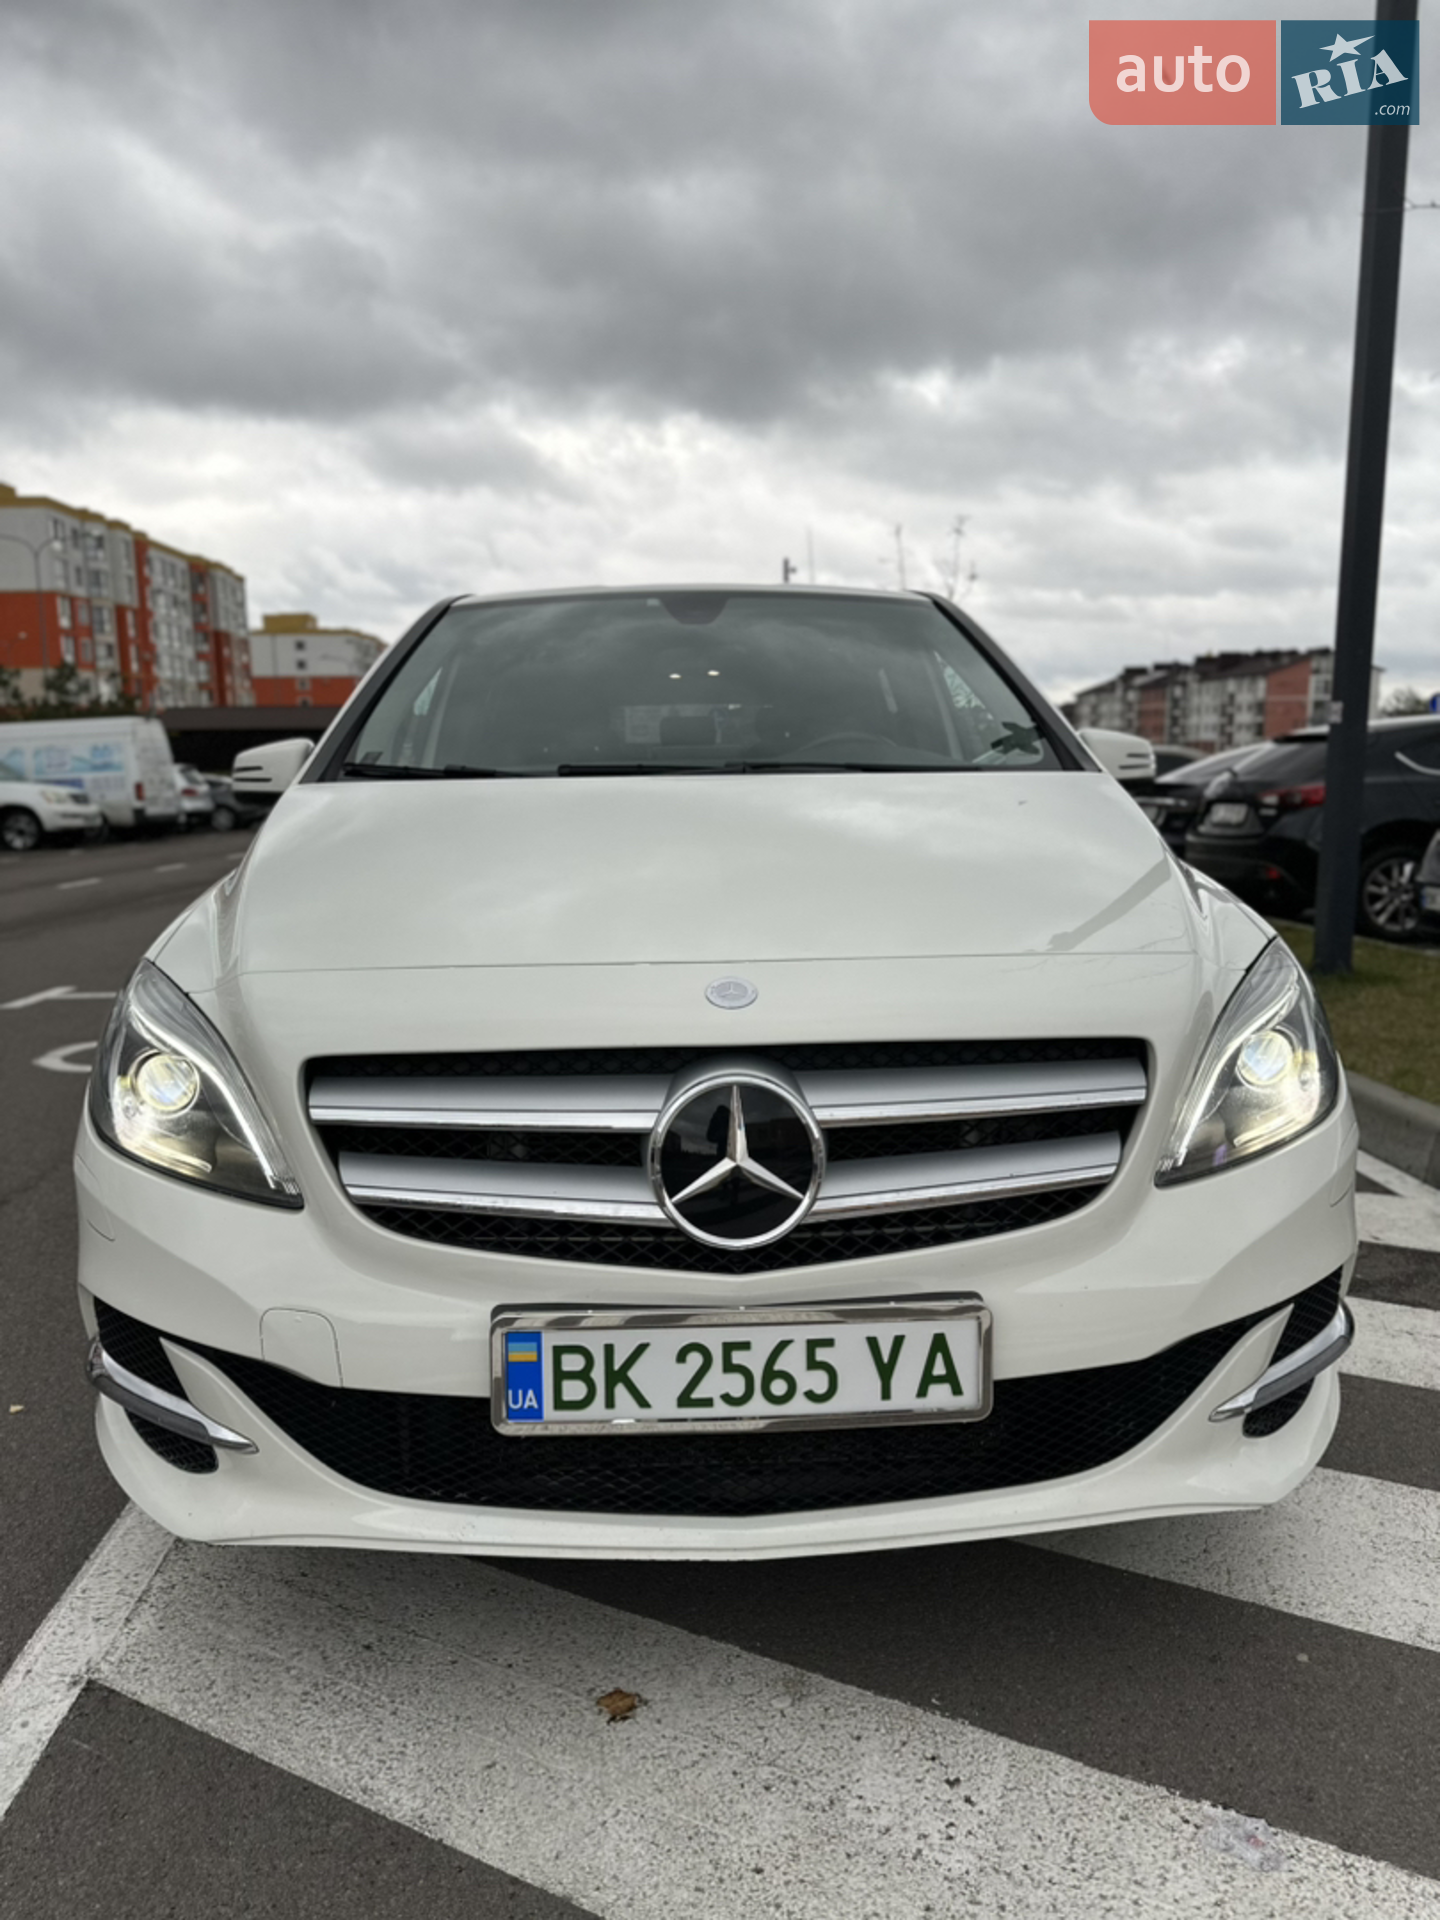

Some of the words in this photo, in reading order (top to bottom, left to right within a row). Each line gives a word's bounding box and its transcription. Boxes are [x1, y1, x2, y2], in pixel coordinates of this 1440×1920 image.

[552, 1342, 652, 1412] BK
[675, 1338, 839, 1409] 2565
[865, 1332, 964, 1401] YA
[507, 1389, 538, 1410] UA
